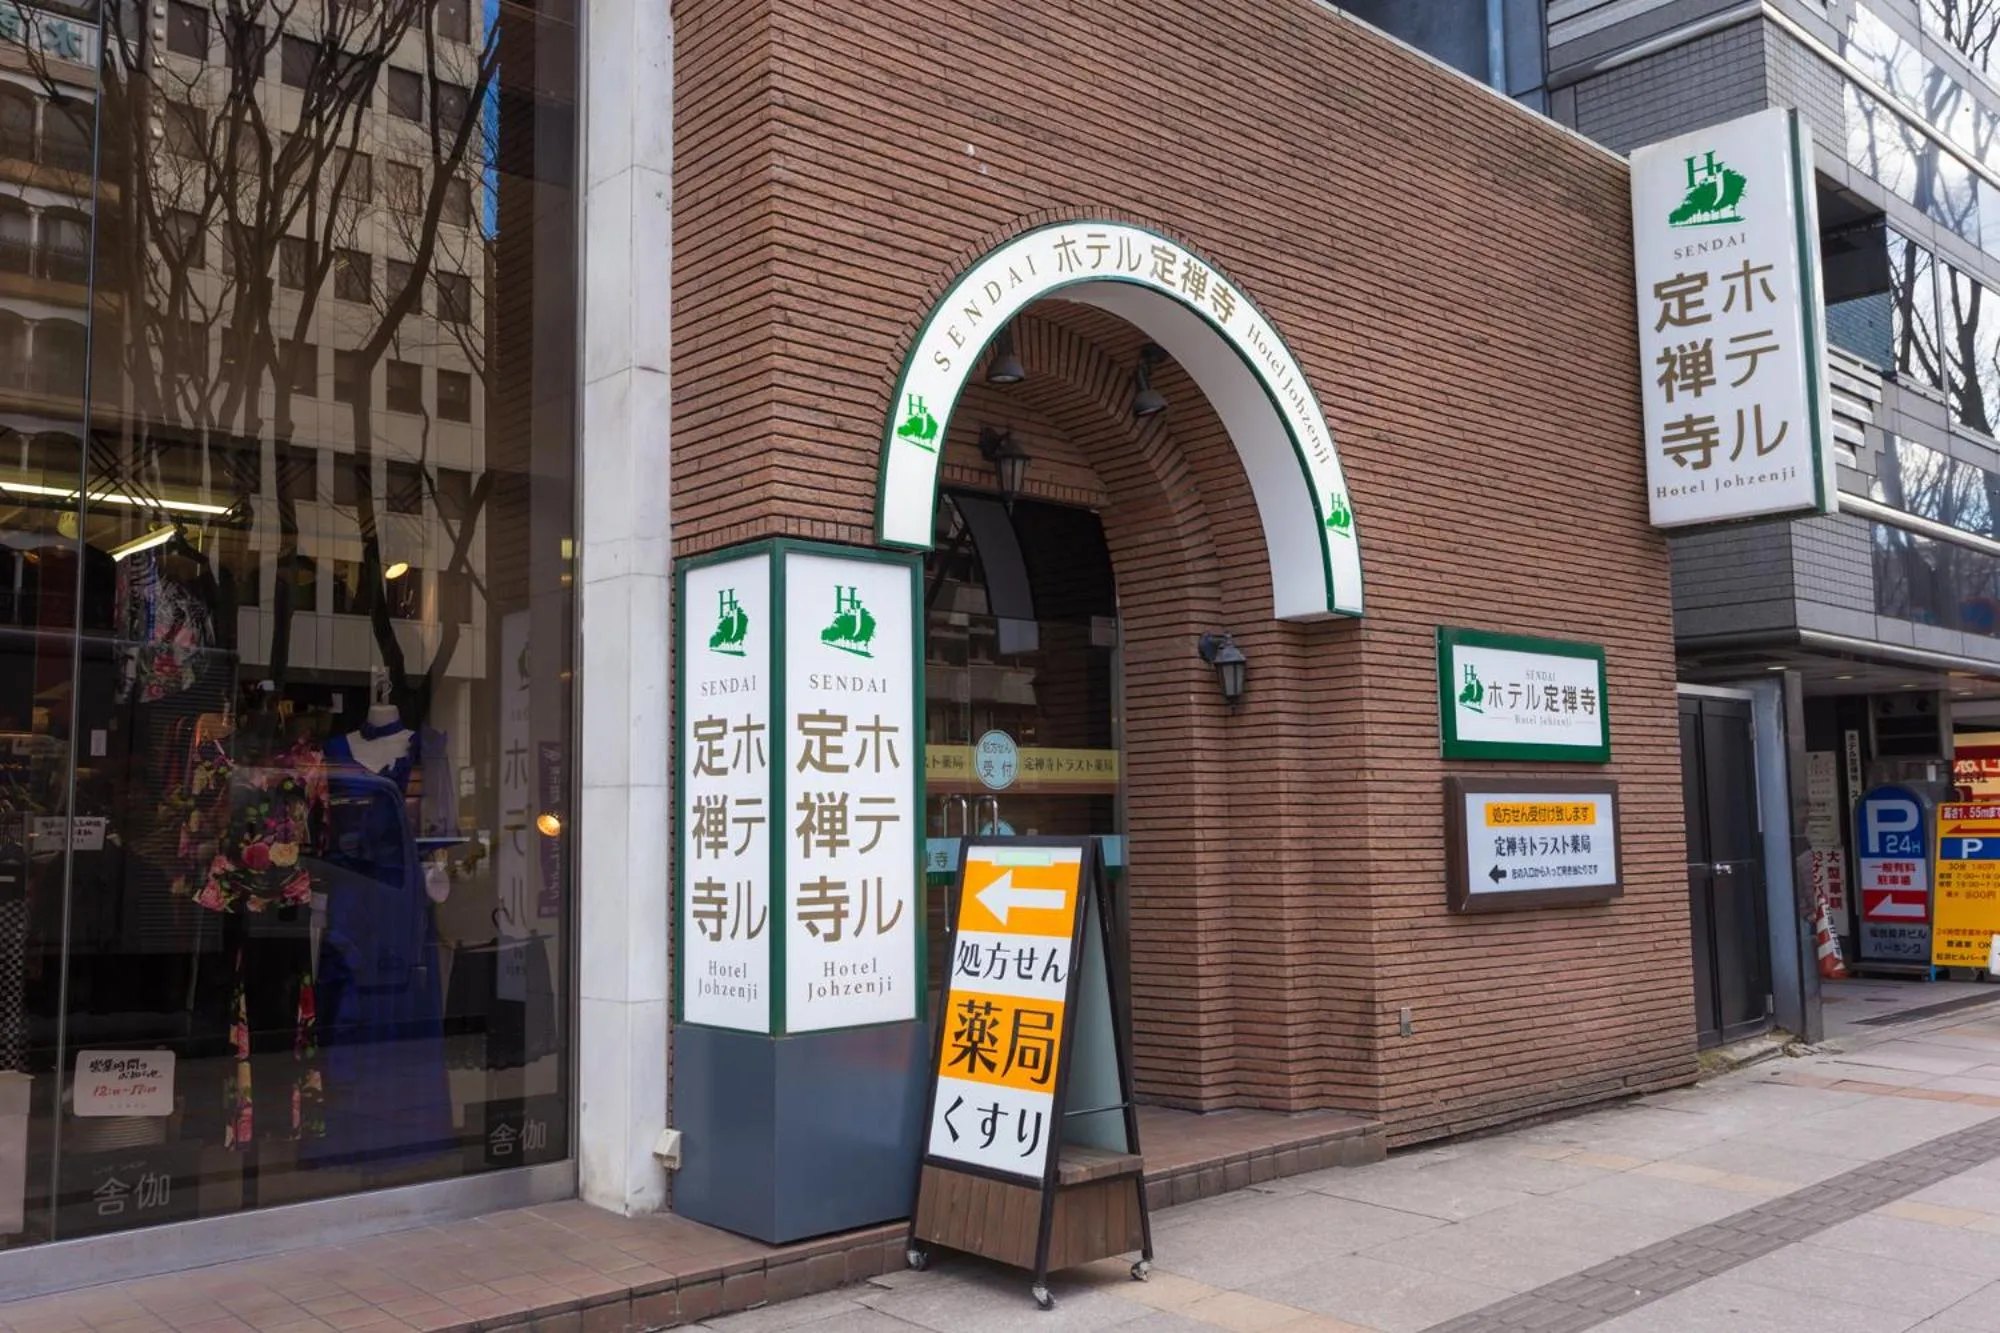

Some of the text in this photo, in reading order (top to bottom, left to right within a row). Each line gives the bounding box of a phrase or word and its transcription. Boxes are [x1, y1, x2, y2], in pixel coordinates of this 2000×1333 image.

[1673, 232, 1747, 260] SENDAI
[934, 256, 1037, 373] SENDAI
[1653, 272, 1720, 471] 定禅寺
[1721, 259, 1789, 462] ホテル
[1246, 323, 1331, 465] Hotel Johzenji
[1656, 467, 1797, 498] Hotel Johzenji
[701, 675, 757, 696] SENDAI
[808, 674, 888, 694] SENDAI
[1526, 670, 1556, 681] SENDAI
[1488, 681, 1596, 715] ホテル定禅寺
[1023, 756, 1113, 773] 定禅寺トラスト薬局
[692, 714, 729, 943] 定禅寺
[731, 713, 767, 940] ホテル
[795, 708, 851, 944] 定禅寺
[854, 713, 904, 938] ホテル
[1492, 806, 1590, 823] 処方せん受付け致します
[1866, 799, 1919, 853] P
[1494, 834, 1592, 858] 定禅寺トラスト薬局
[1886, 834, 1921, 853] 24H
[1961, 838, 1983, 859] P
[708, 959, 747, 980] Hotel
[823, 957, 878, 978] Hotel
[955, 941, 1066, 983] 処方せん
[698, 978, 758, 1000] Johzenji
[807, 977, 893, 1003] Johzenji
[948, 999, 1055, 1085] 薬局
[944, 1095, 1042, 1158] くすり
